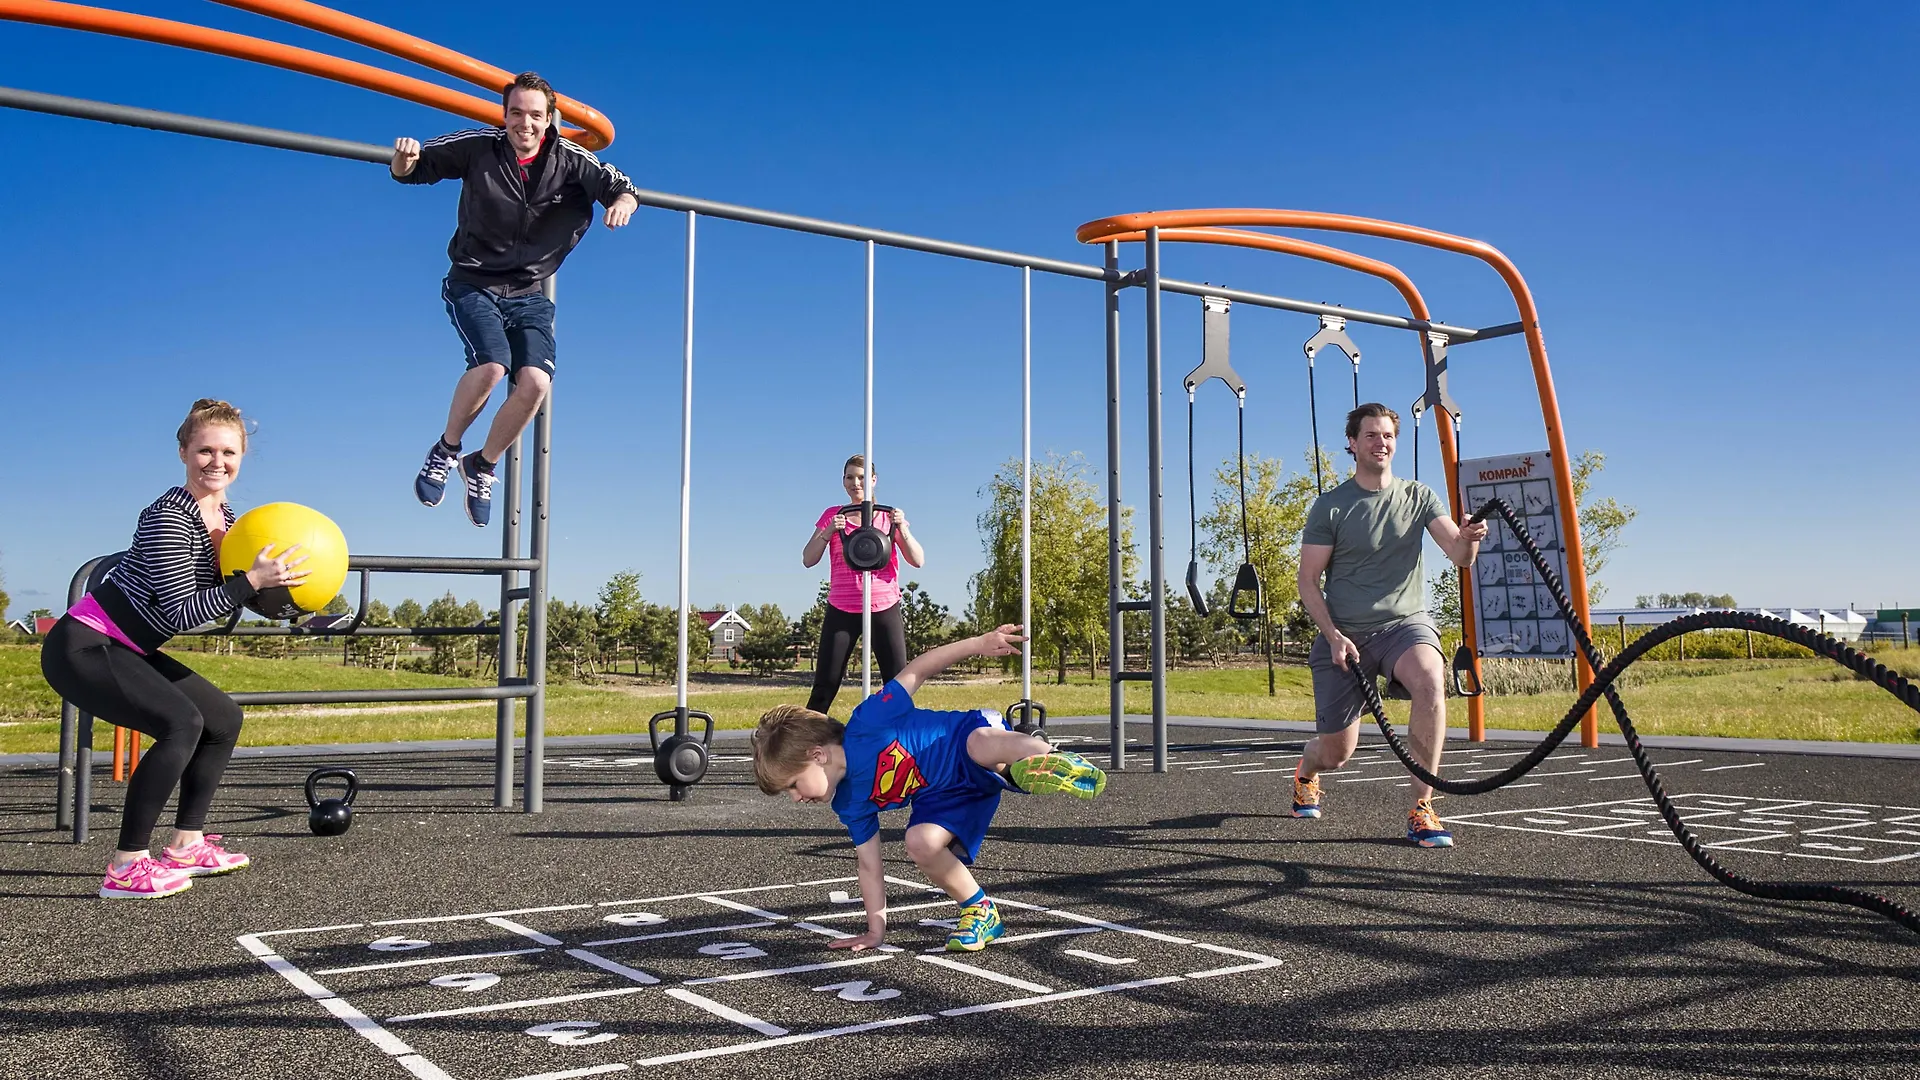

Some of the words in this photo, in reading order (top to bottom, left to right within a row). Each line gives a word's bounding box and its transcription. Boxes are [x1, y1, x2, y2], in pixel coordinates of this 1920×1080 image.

[1478, 467, 1527, 481] KOMPAN
[602, 911, 670, 926] 8
[698, 942, 768, 961] 5
[1064, 948, 1139, 966] 1
[811, 980, 903, 1002] 2
[524, 1020, 619, 1046] 3
